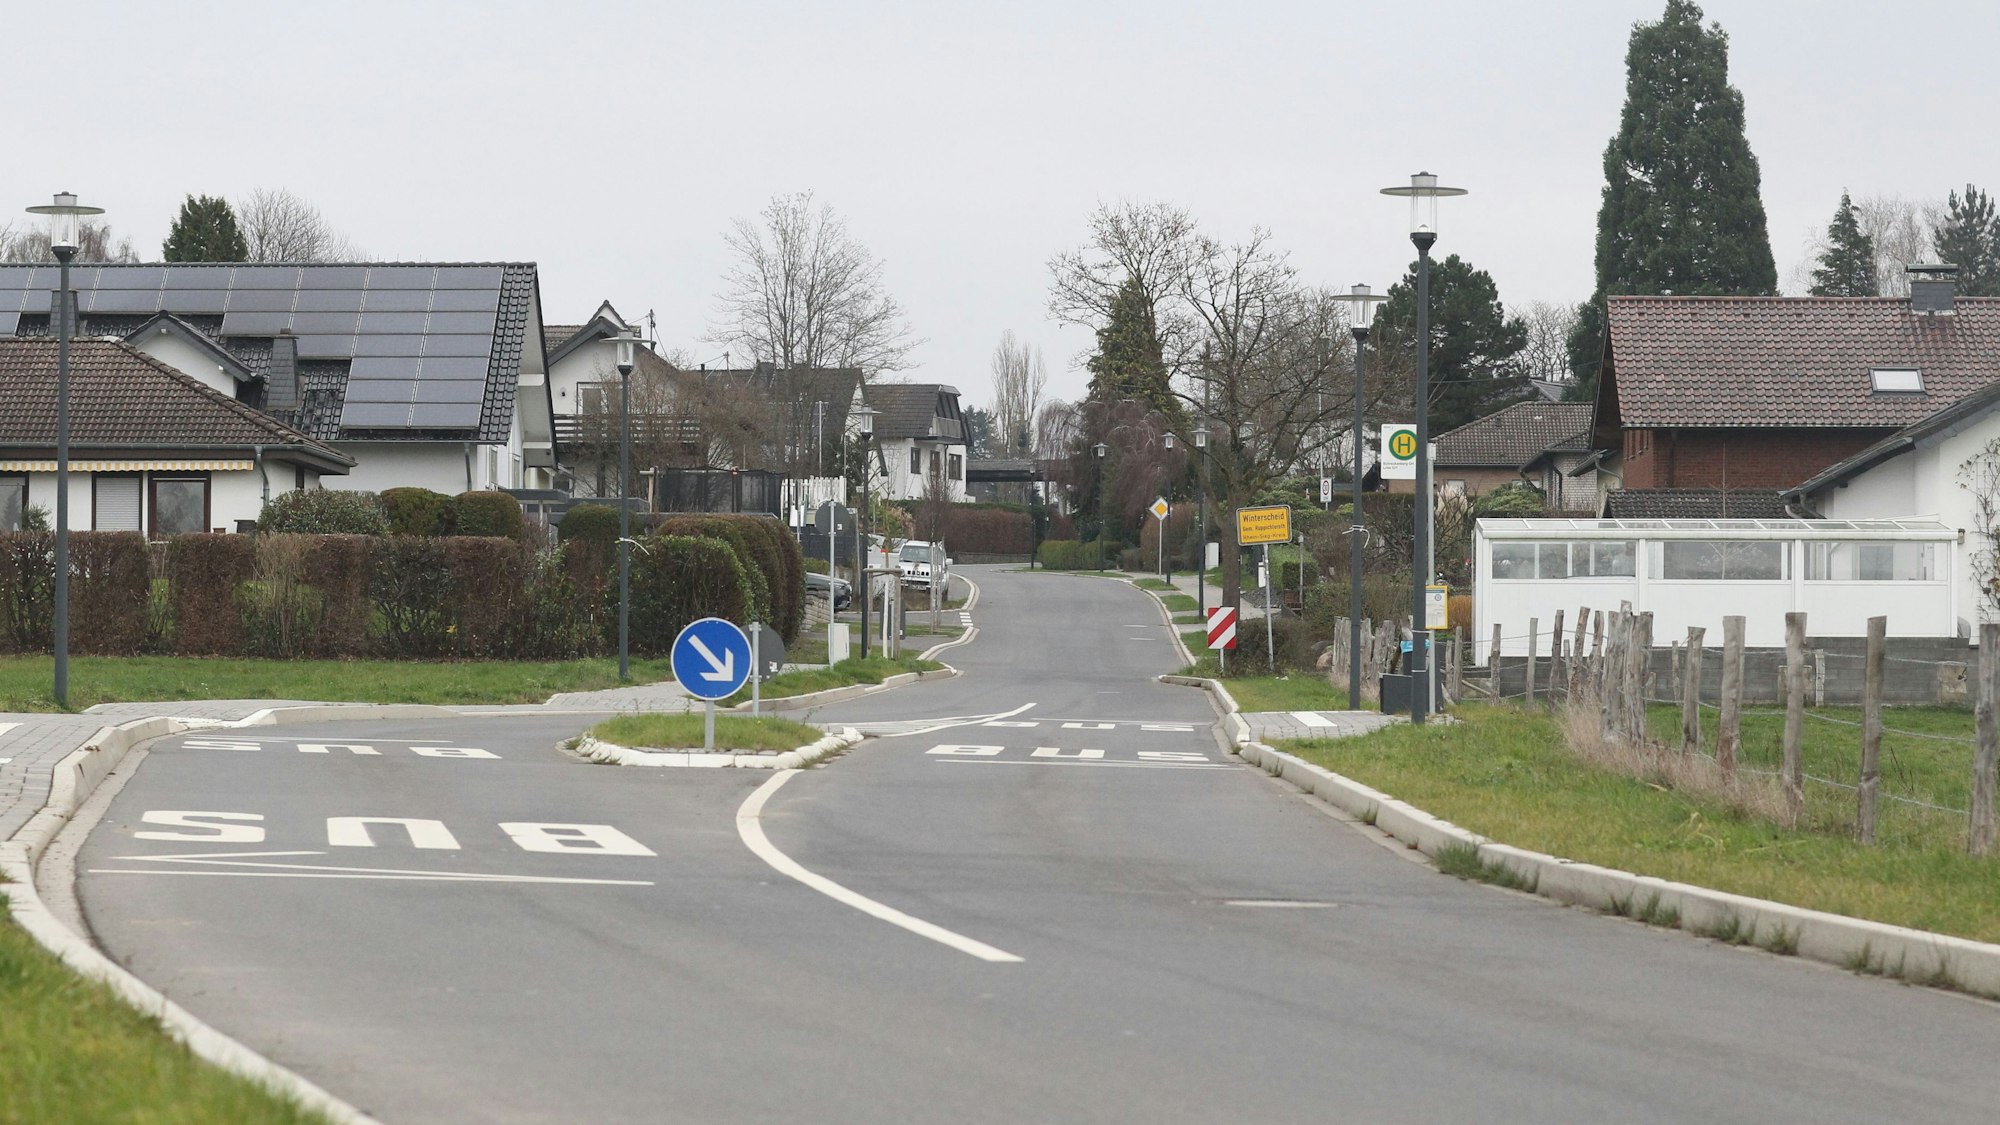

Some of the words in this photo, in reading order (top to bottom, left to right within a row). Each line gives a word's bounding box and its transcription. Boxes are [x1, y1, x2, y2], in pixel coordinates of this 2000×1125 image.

[1398, 436, 1411, 454] H
[1243, 512, 1285, 522] Winterscheid
[981, 721, 1195, 732] BUS
[180, 740, 503, 759] BUS
[924, 744, 1210, 762] BUS
[133, 810, 658, 857] BUS
